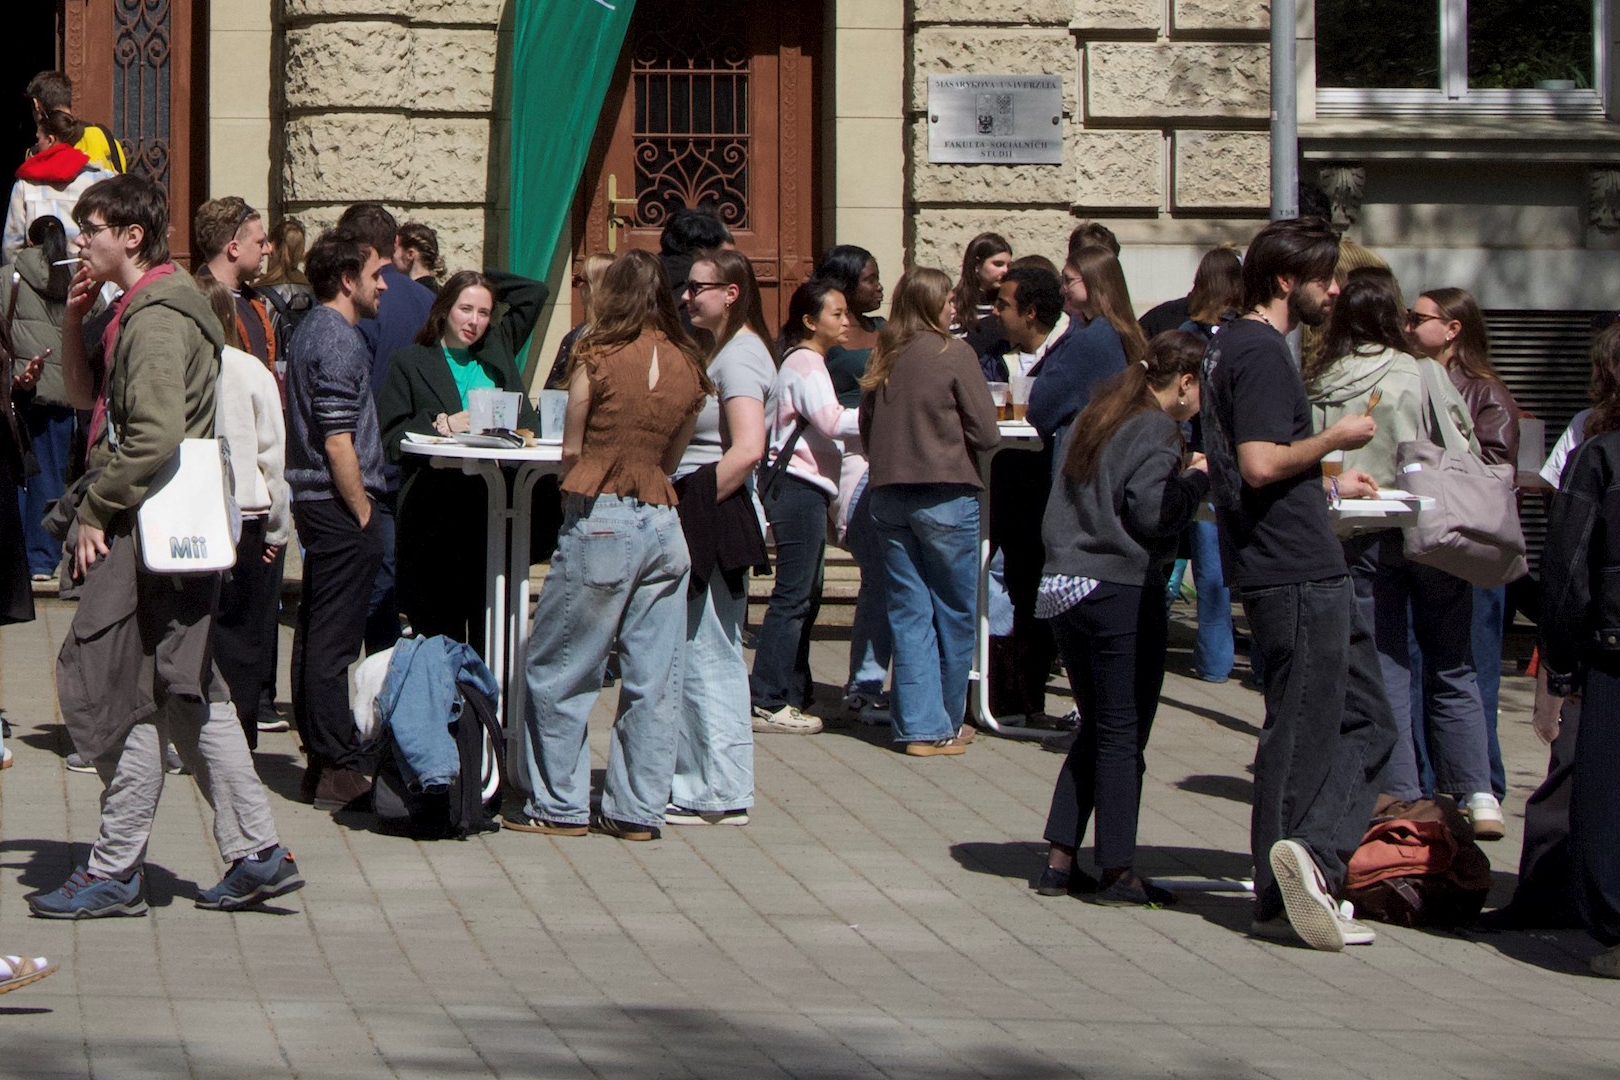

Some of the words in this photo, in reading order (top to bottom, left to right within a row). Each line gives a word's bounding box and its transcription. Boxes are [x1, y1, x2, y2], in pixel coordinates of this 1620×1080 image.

[936, 80, 995, 89] MASARYKOVA
[1000, 80, 1057, 89] UNIVERZITA
[944, 140, 985, 149] FAKULTA
[169, 536, 208, 559] Mii
